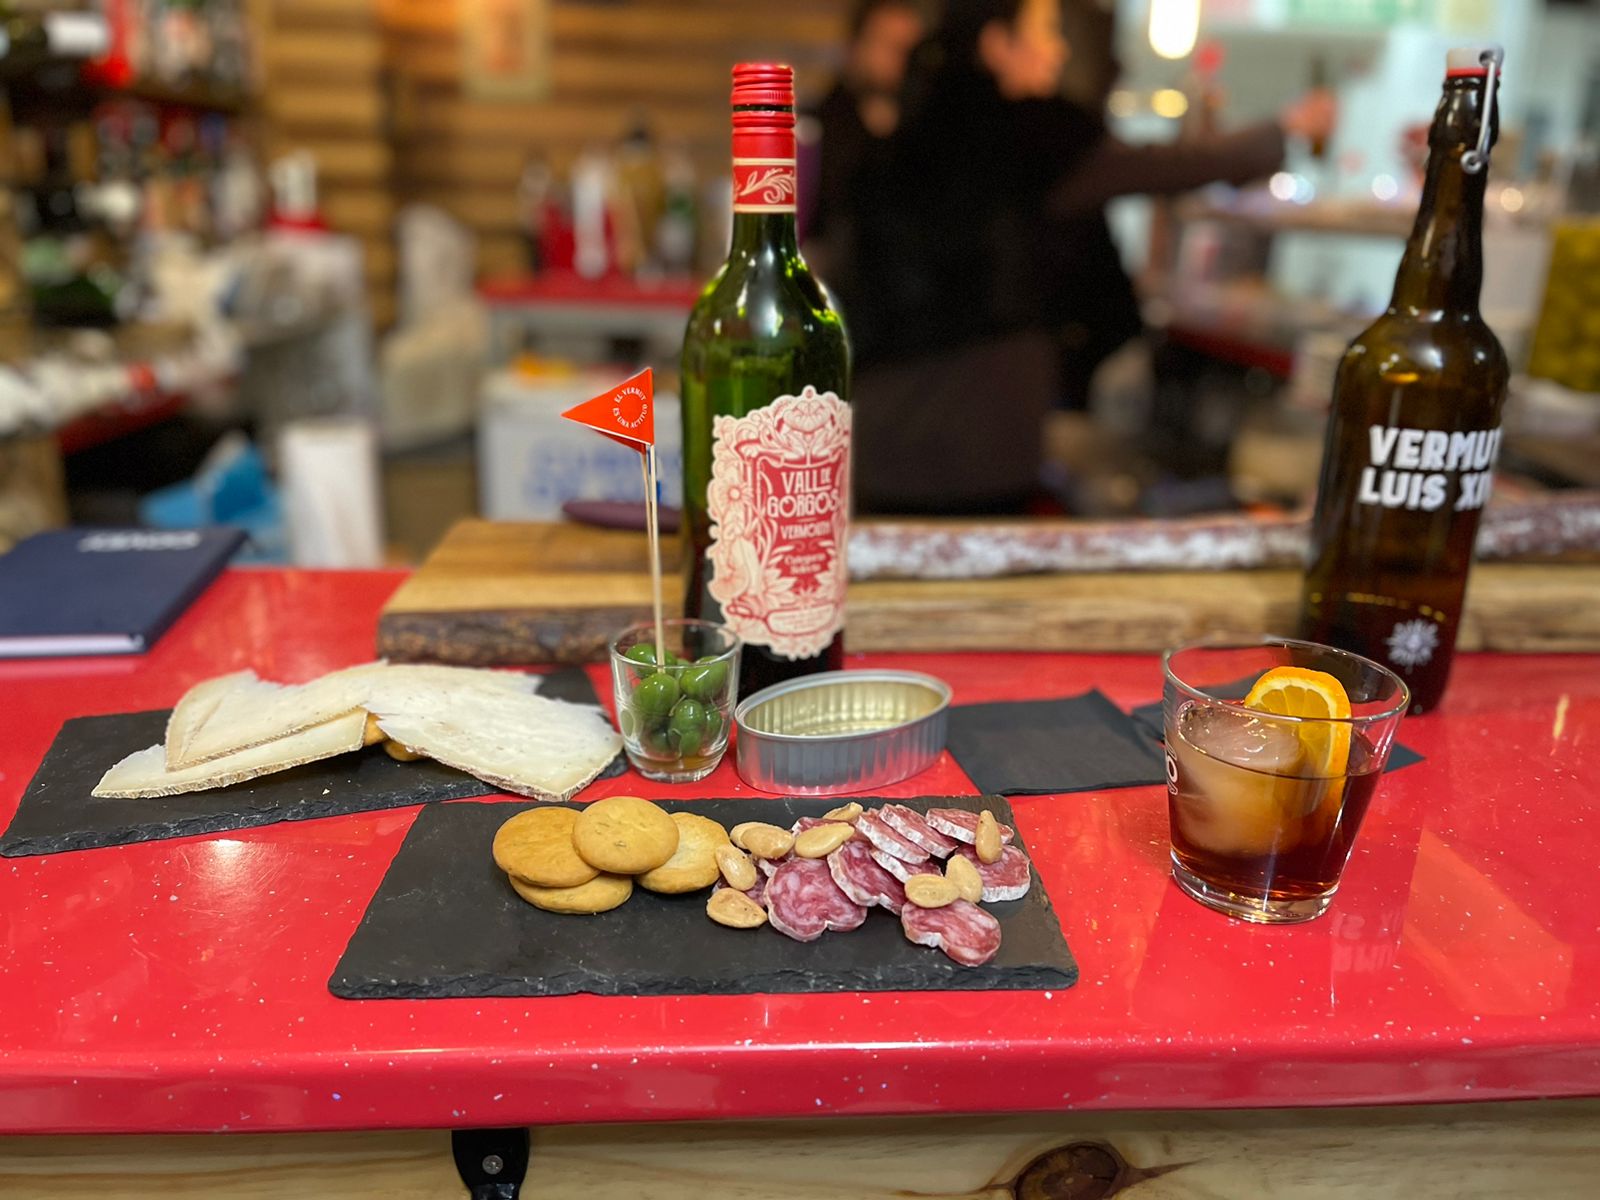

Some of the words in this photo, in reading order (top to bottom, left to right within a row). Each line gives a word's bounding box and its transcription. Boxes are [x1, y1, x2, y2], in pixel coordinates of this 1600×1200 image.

[614, 394, 623, 403] EL
[622, 387, 646, 400] VERMUT
[613, 408, 620, 416] ES
[617, 416, 629, 428] UNA
[631, 404, 648, 428] ACTITUD
[781, 469, 832, 494] VALL
[1359, 467, 1447, 511] LUIS
[767, 489, 839, 518] GORGOS
